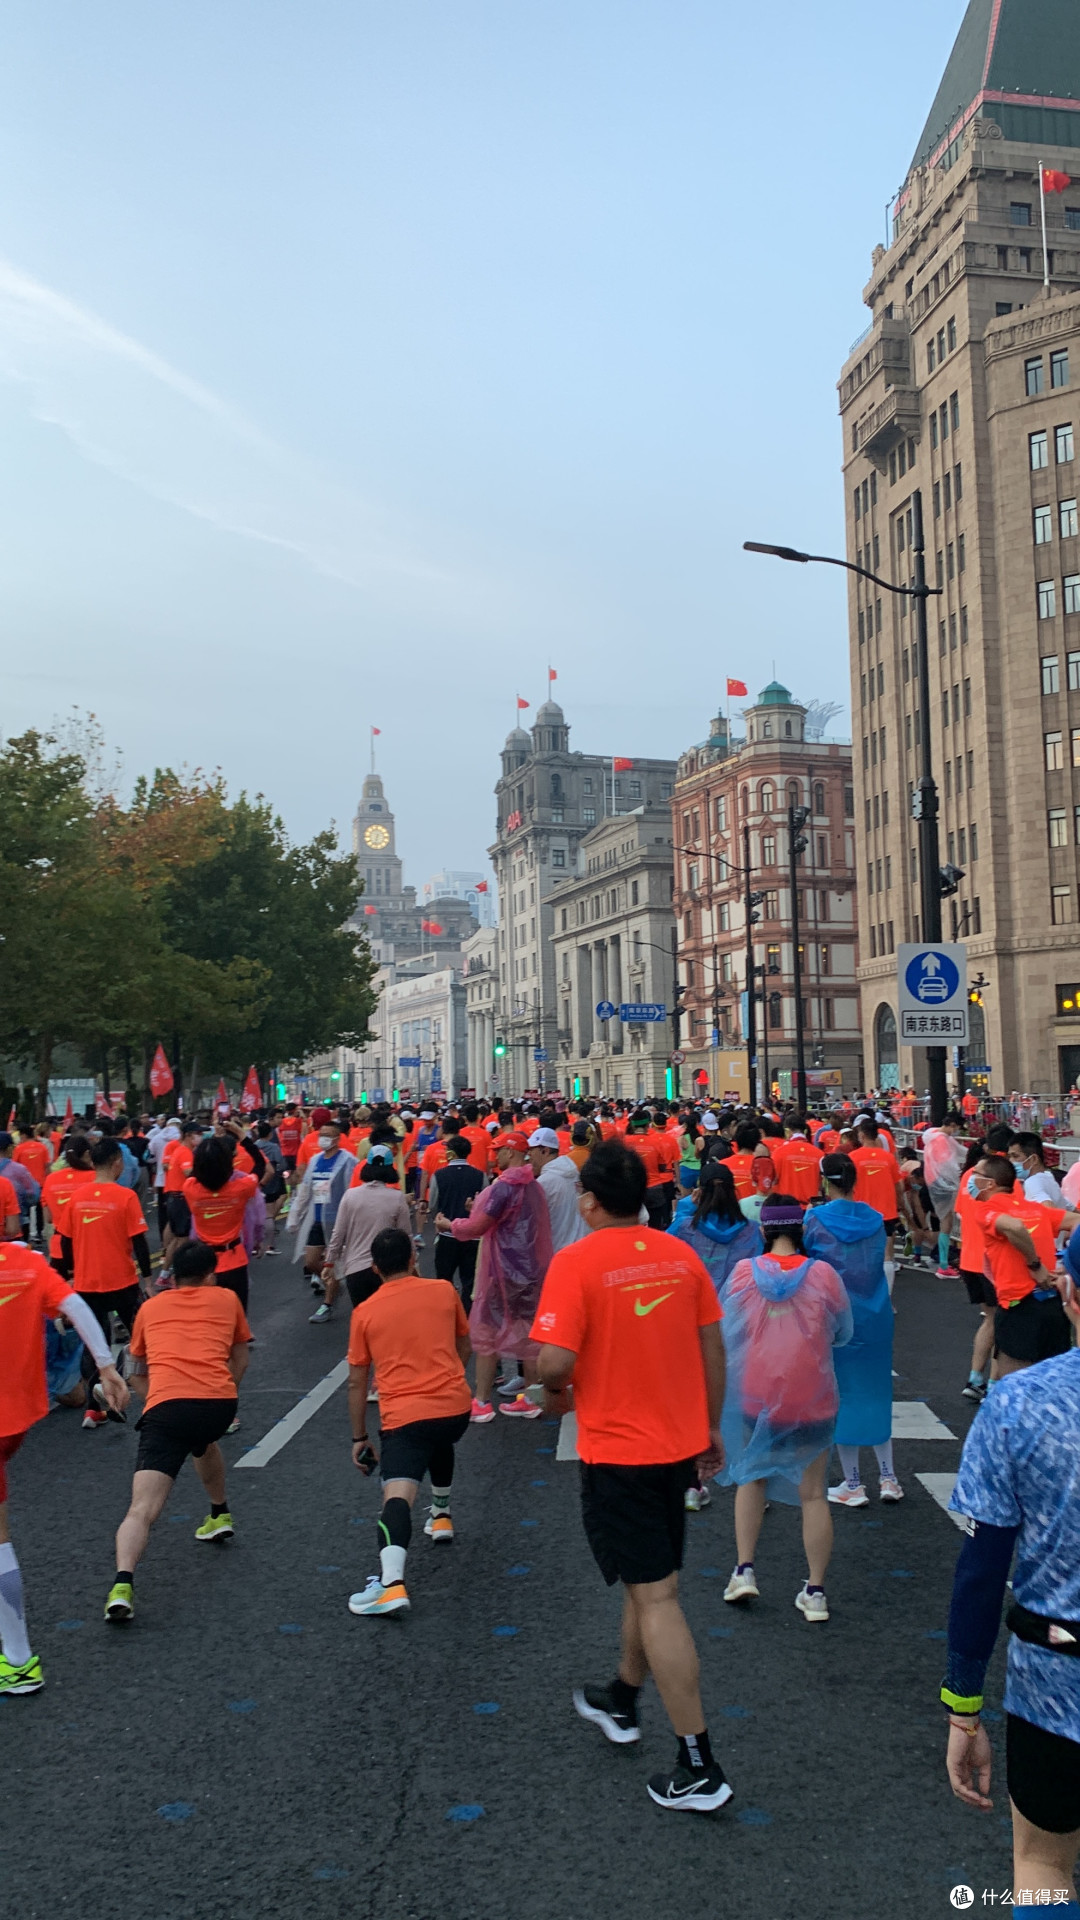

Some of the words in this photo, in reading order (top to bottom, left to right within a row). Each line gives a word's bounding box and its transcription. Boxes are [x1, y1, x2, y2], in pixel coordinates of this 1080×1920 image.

[507, 809, 522, 832] AIA
[905, 1016, 962, 1033] 南京东路口
